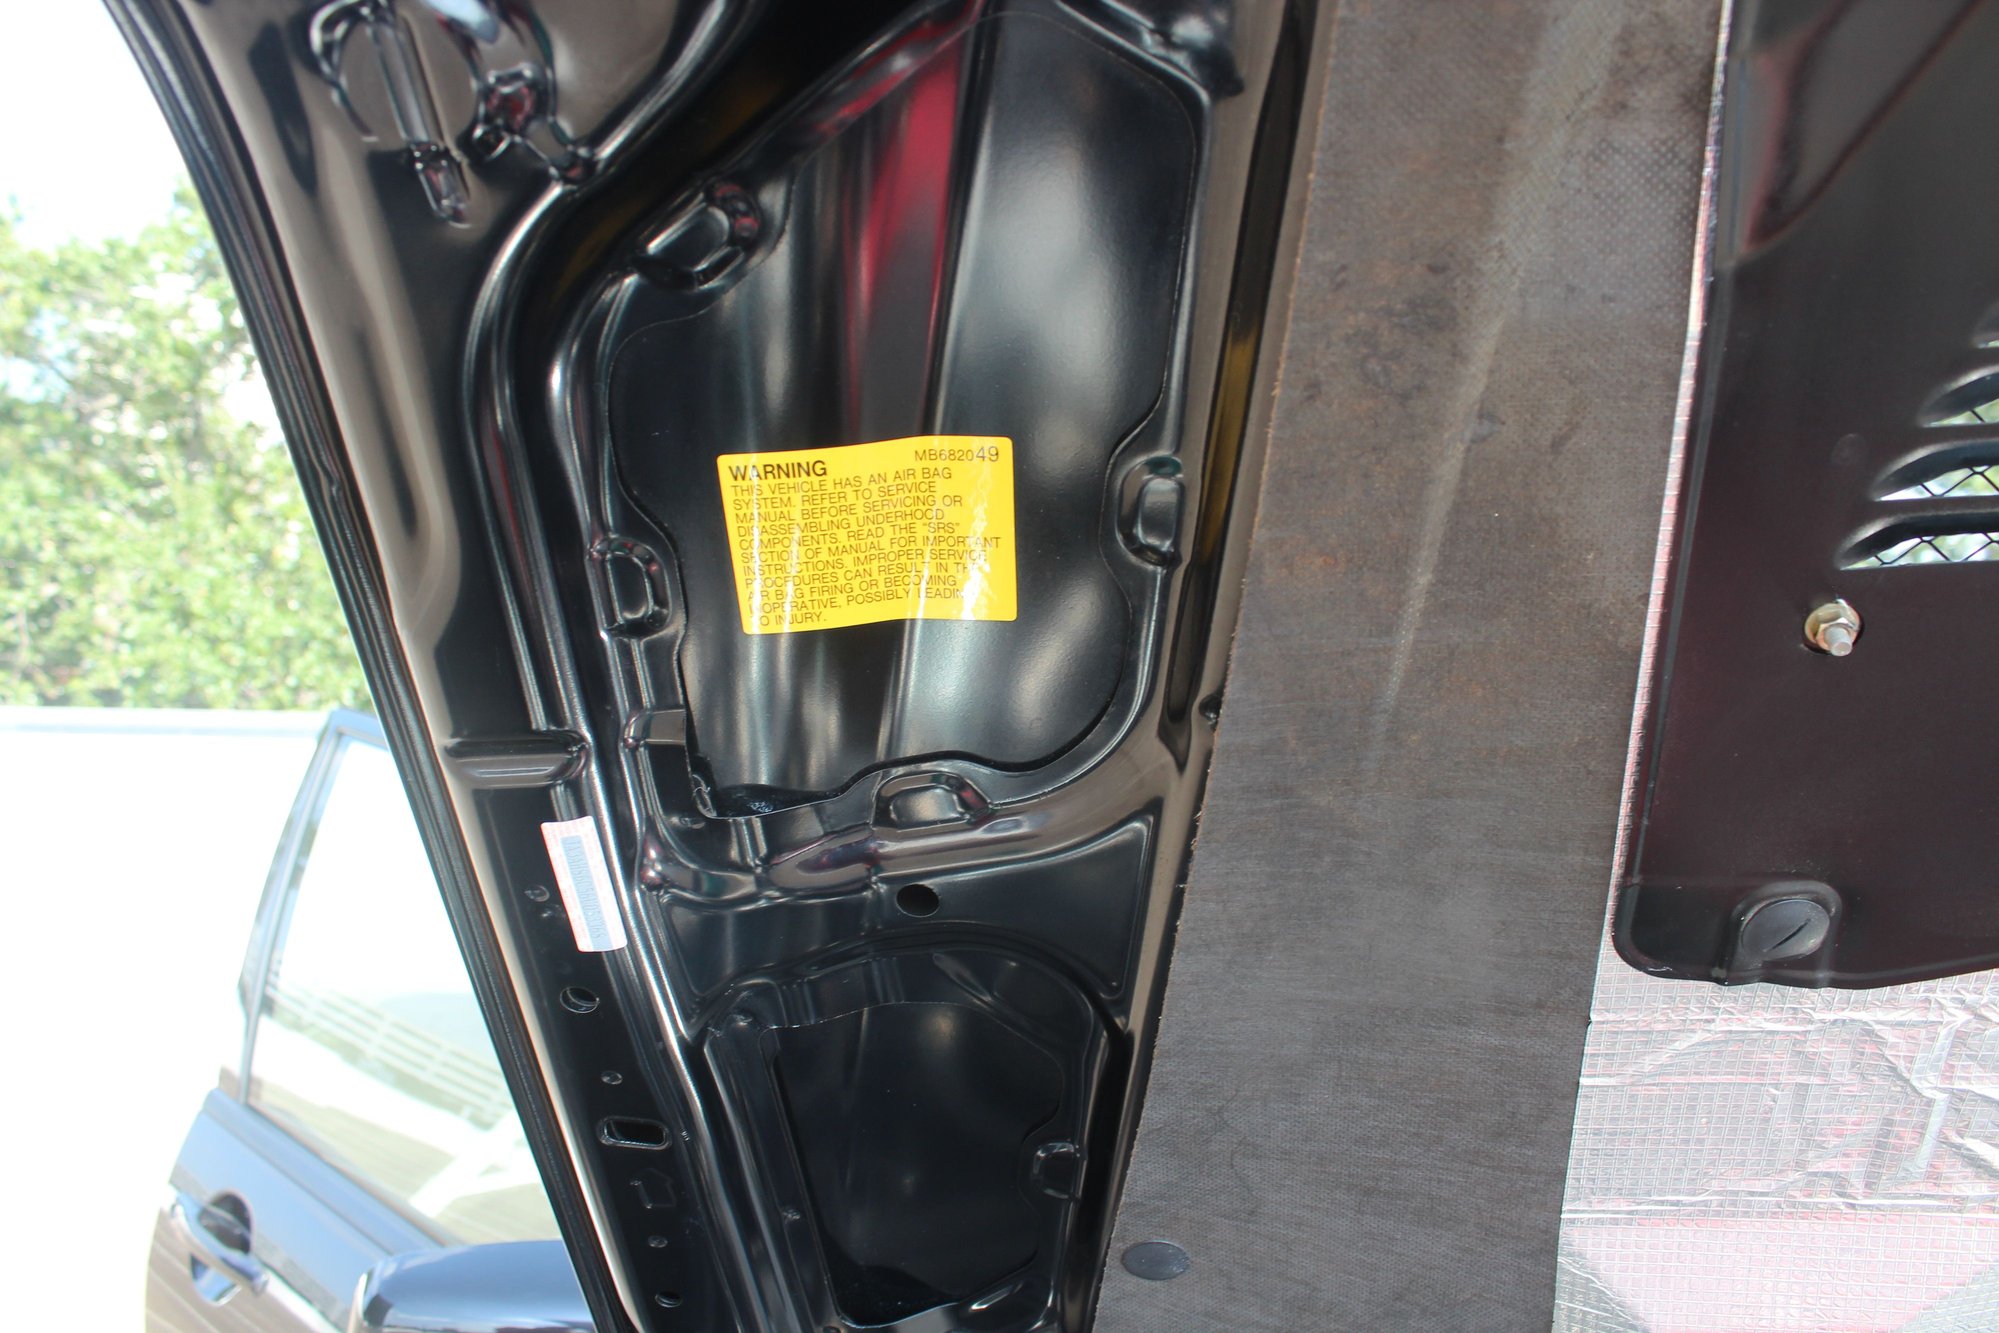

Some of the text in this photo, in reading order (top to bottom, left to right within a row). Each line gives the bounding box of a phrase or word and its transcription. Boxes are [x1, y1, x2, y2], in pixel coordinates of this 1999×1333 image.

[914, 446, 999, 462] MB682049
[728, 460, 827, 481] WARNING
[731, 467, 952, 497] THIS VEHICLE HAS AN AIR BAG
[733, 481, 937, 511] SYSTEM. REFER TO SERVICE
[735, 495, 963, 524] MANUAL BEFORE SERVICING OR
[737, 508, 944, 538] DISASSEMBLING UNDERHOOD
[739, 532, 842, 551] COMPONENTS.
[847, 527, 885, 542] READ
[890, 522, 917, 535] THE
[804, 547, 823, 560] OF
[828, 540, 885, 558] MANUAL
[890, 536, 917, 549] FOR
[922, 535, 1002, 548] IMPORTANT
[853, 549, 924, 568] IMPROPER
[930, 549, 987, 562] SERVICE
[745, 571, 839, 589] POCEDURES
[844, 567, 873, 581] CAN
[936, 562, 948, 573] IN
[748, 575, 957, 602] AR BG FIRING OR BECOMING
[749, 587, 968, 614] IOPERATIVE, POSSIBLY LEADIN
